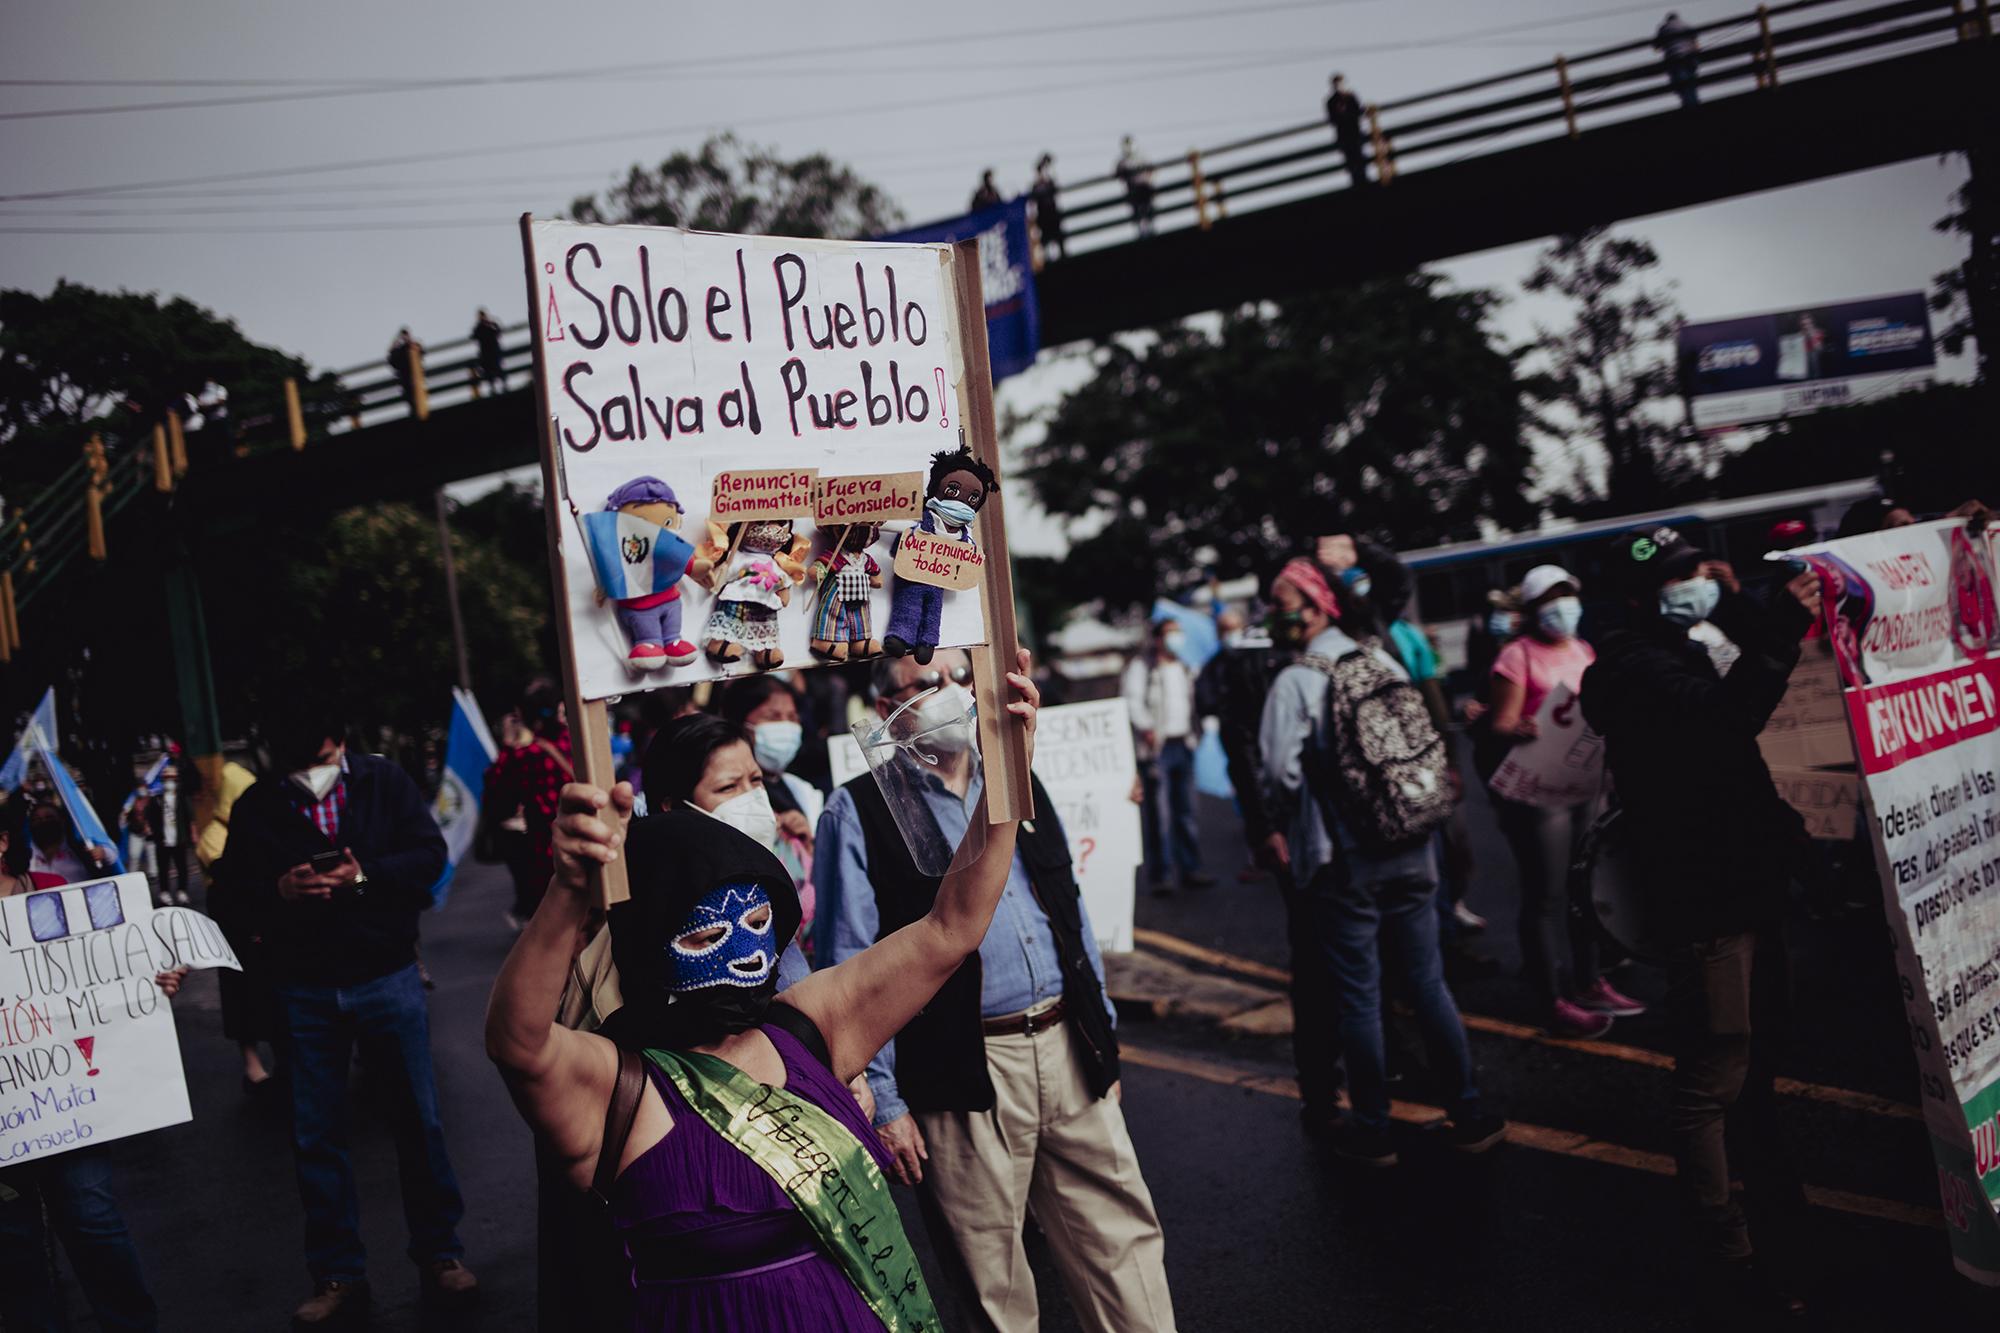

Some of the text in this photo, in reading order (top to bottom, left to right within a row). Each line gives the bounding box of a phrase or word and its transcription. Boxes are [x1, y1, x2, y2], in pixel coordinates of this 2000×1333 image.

[546, 243, 689, 350] ¡Solo
[706, 248, 751, 342] el
[773, 253, 927, 351] Pueblo
[562, 357, 949, 453] Salva al Pueblo!
[714, 473, 810, 497] ¡Renuncia
[817, 479, 882, 499] ¡Fuera
[715, 491, 815, 514] Giammattei!
[899, 533, 928, 552] ¡Que
[1971, 768, 1996, 797] las
[66, 987, 112, 1031] ME
[121, 975, 157, 1021] LO
